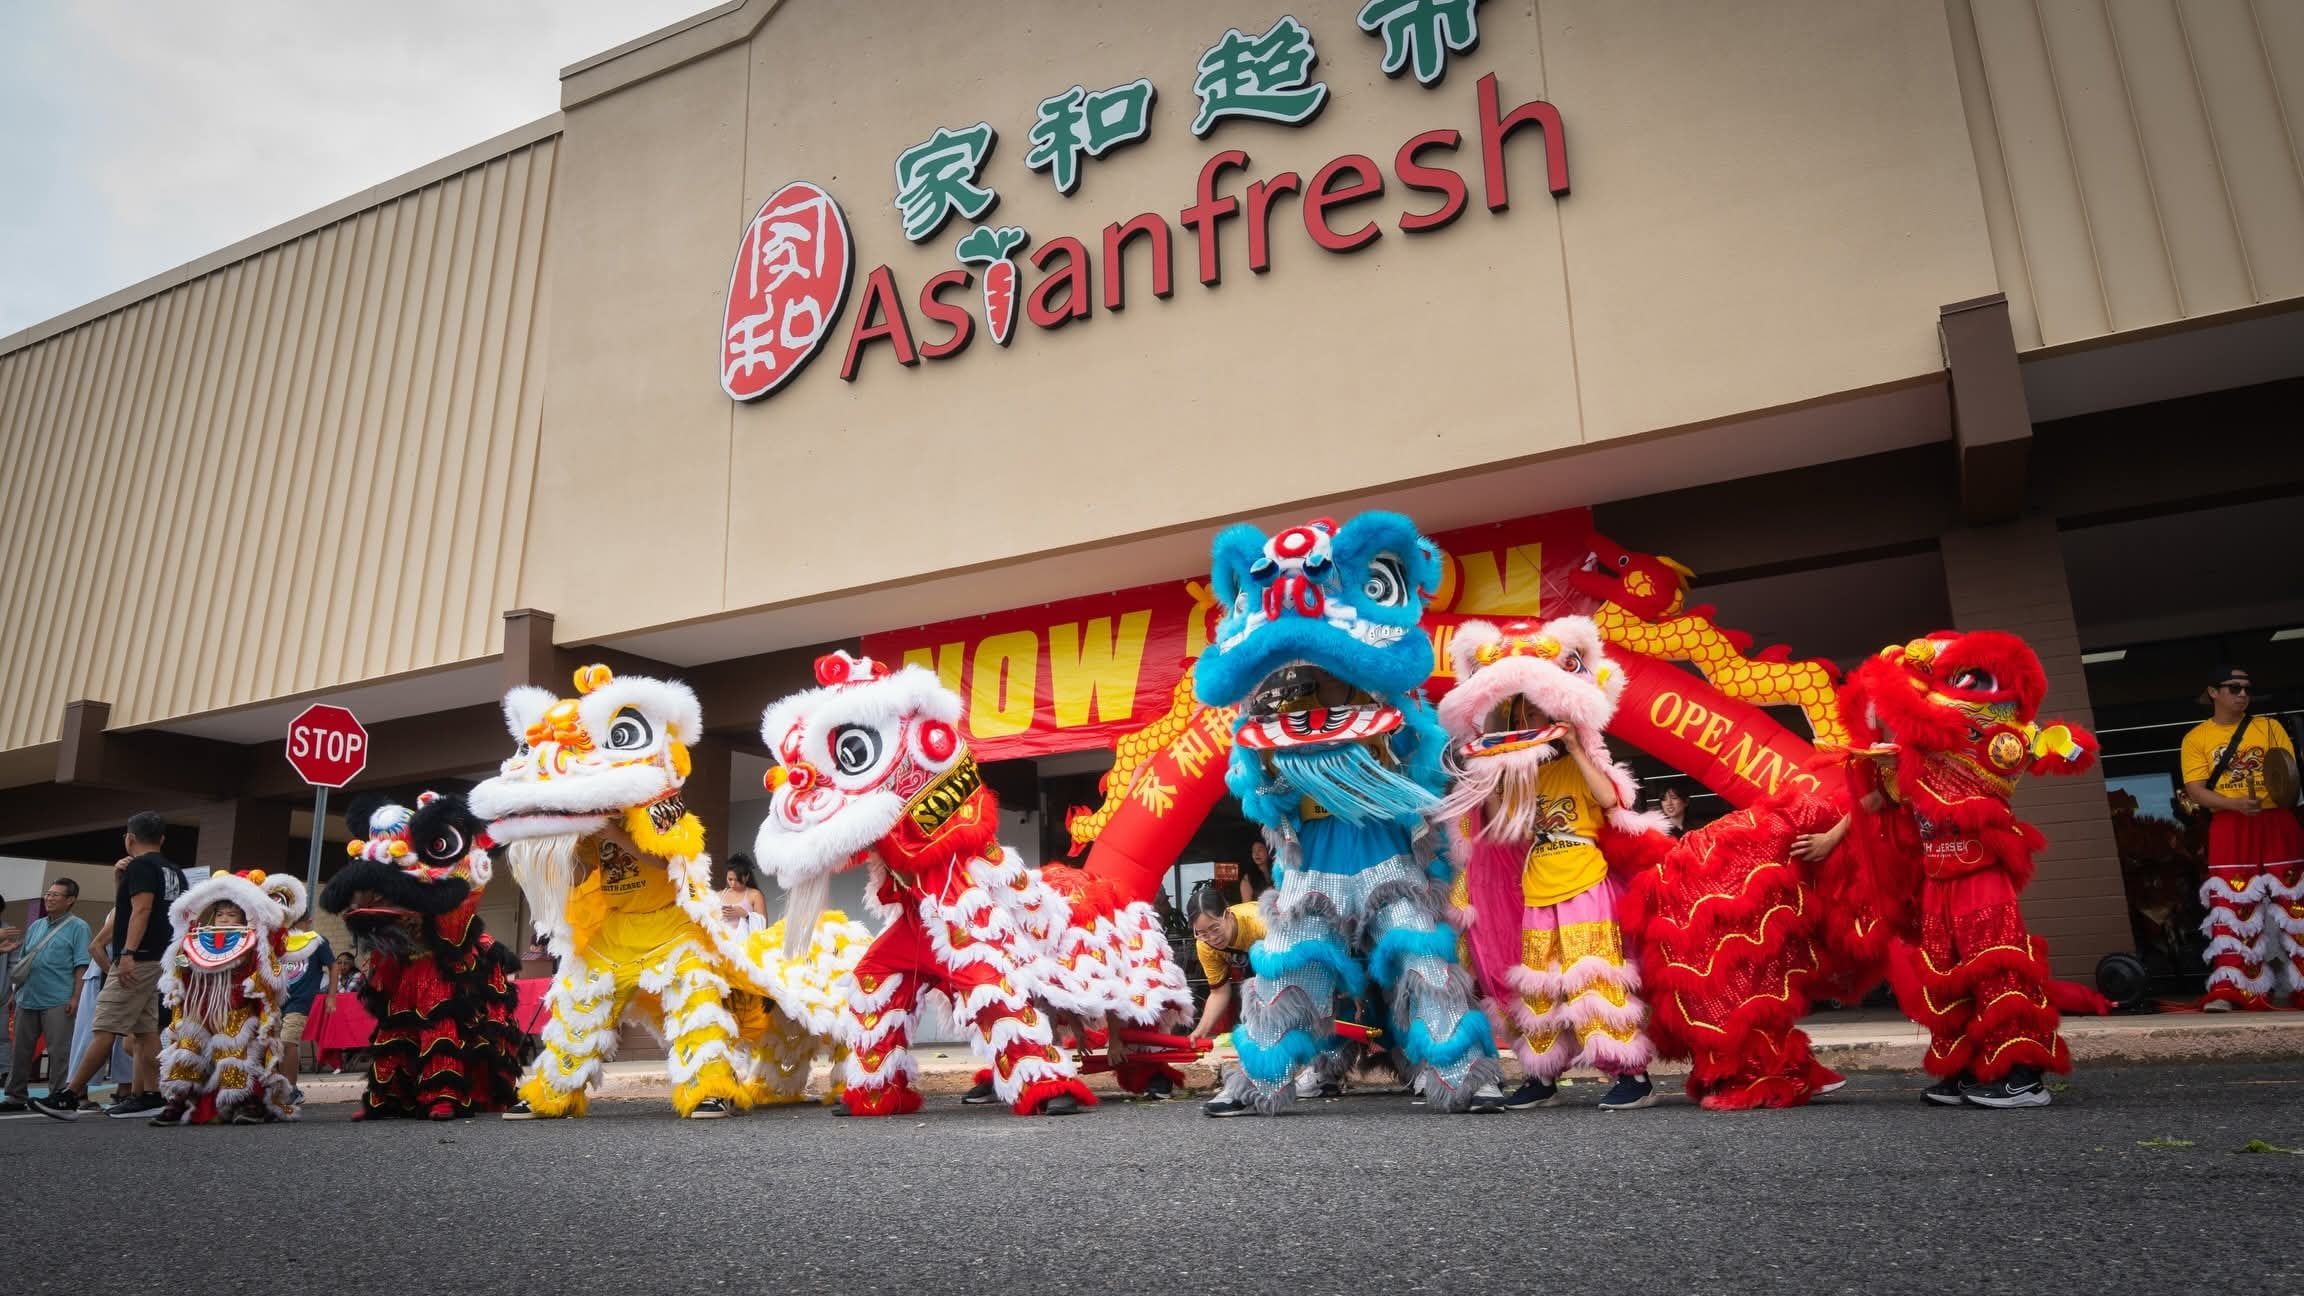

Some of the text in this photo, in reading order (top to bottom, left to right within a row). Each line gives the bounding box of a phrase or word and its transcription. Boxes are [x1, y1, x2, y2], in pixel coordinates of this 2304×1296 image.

[895, 0, 1479, 243] 家和超市
[841, 71, 1571, 381] Asianfresh
[293, 726, 362, 763] STOP
[902, 609, 1152, 739] NOW
